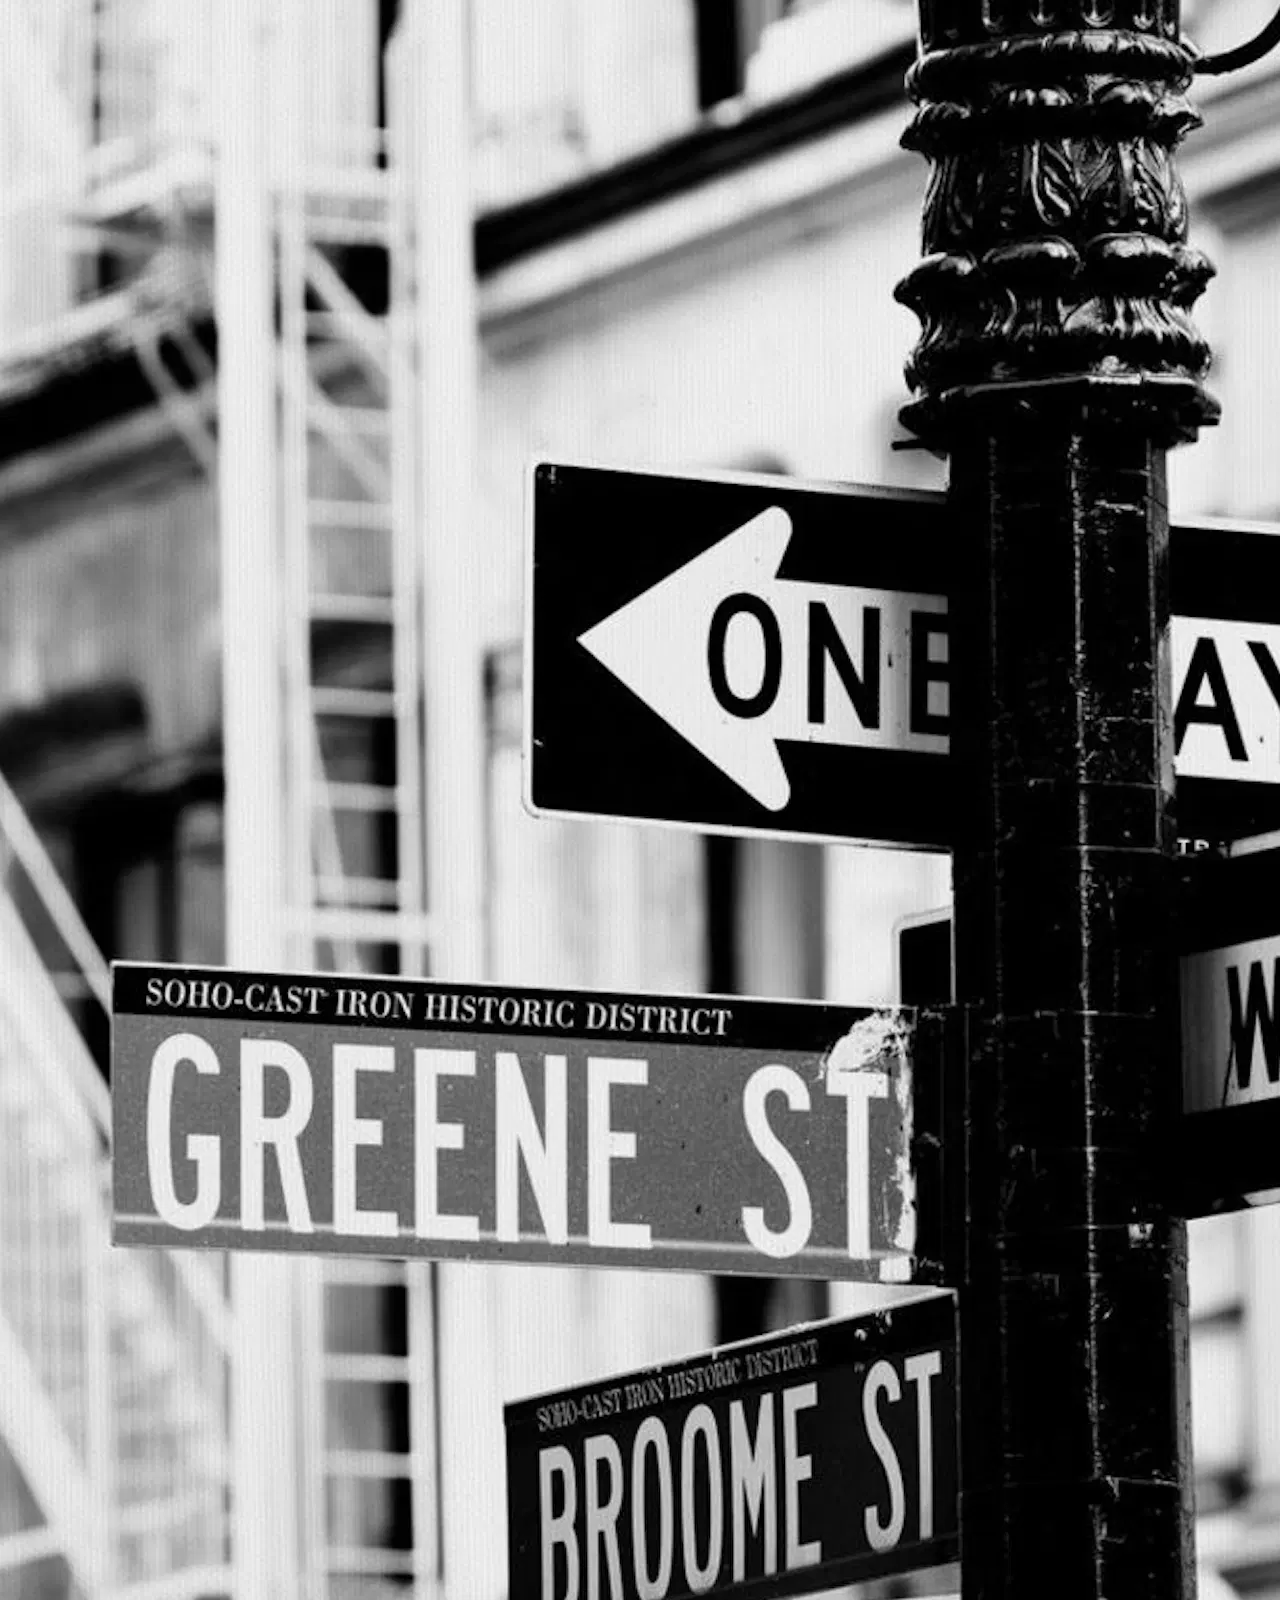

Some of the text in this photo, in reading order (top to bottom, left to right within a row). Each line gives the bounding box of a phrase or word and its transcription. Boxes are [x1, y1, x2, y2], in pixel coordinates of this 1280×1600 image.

[708, 593, 949, 735] ONE
[146, 978, 732, 1035] SOHO-CAST IRON HISTORIC DISTRICT
[147, 1034, 889, 1259] GREENE ST
[537, 1339, 819, 1432] SOHO-CAST IRON HISTORIC DISTRICT
[863, 1351, 941, 1552] ST
